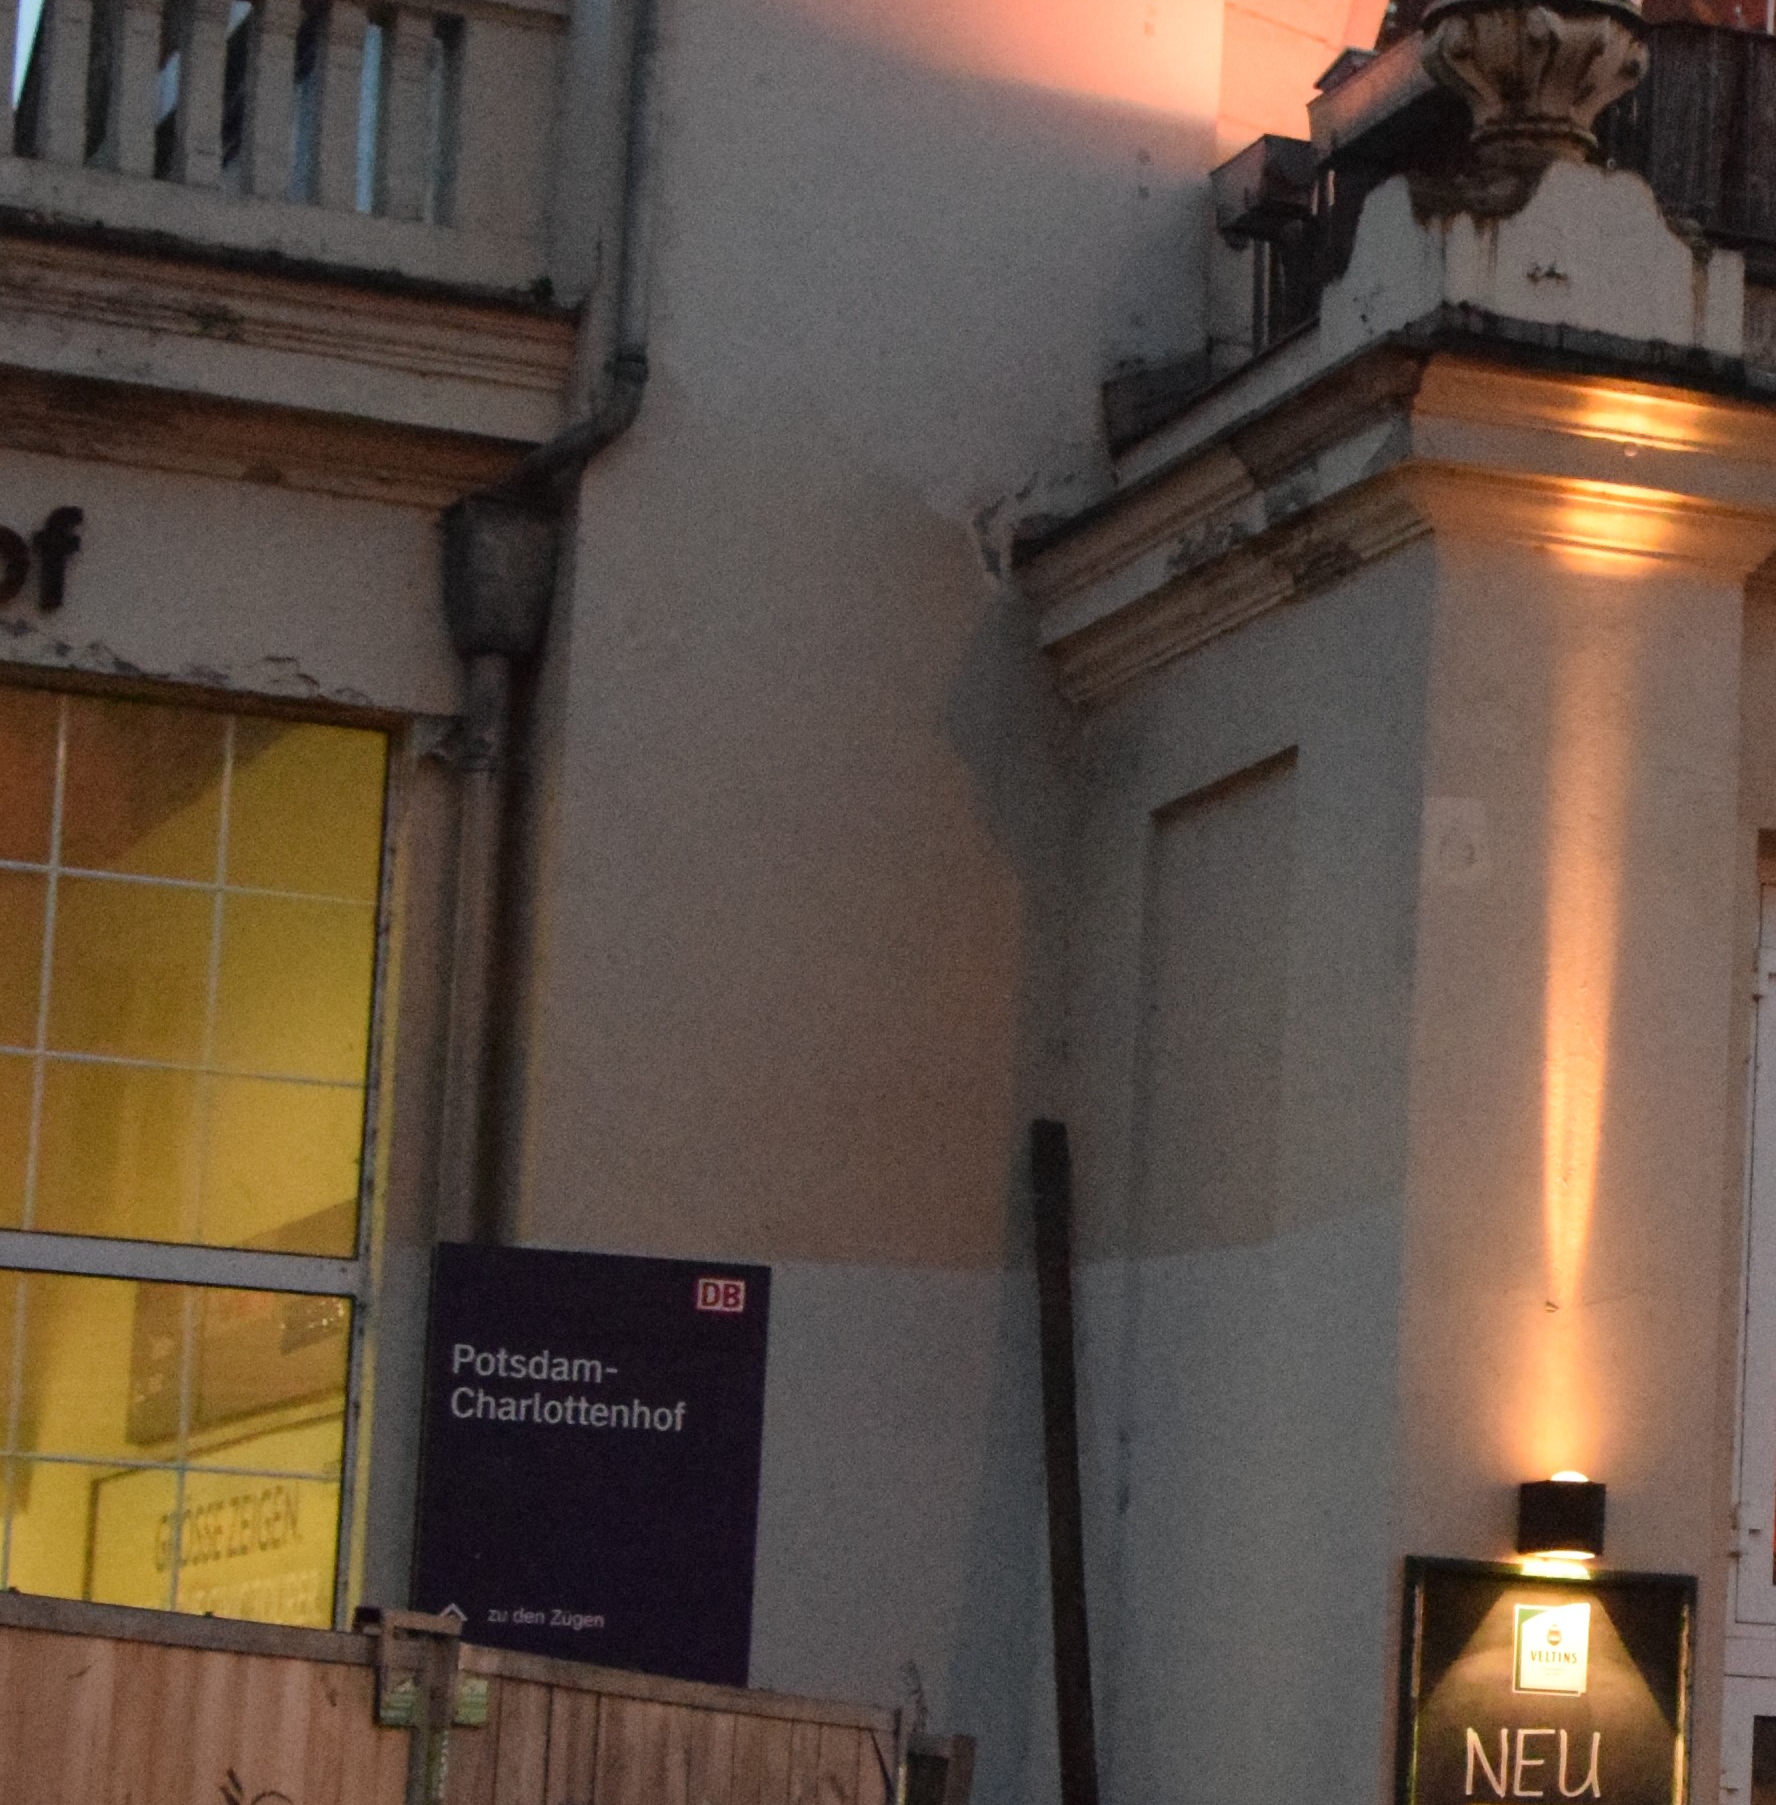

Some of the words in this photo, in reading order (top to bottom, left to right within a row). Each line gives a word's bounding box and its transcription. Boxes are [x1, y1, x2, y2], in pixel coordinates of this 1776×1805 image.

[700, 1280, 743, 1310] DB
[451, 1343, 619, 1384] Potsdam-
[450, 1386, 687, 1432] Charlottenhof
[487, 1608, 508, 1623] zu
[512, 1607, 545, 1625] den
[1530, 1650, 1578, 1665] VELTINS
[1465, 1726, 1602, 1799] NEU
